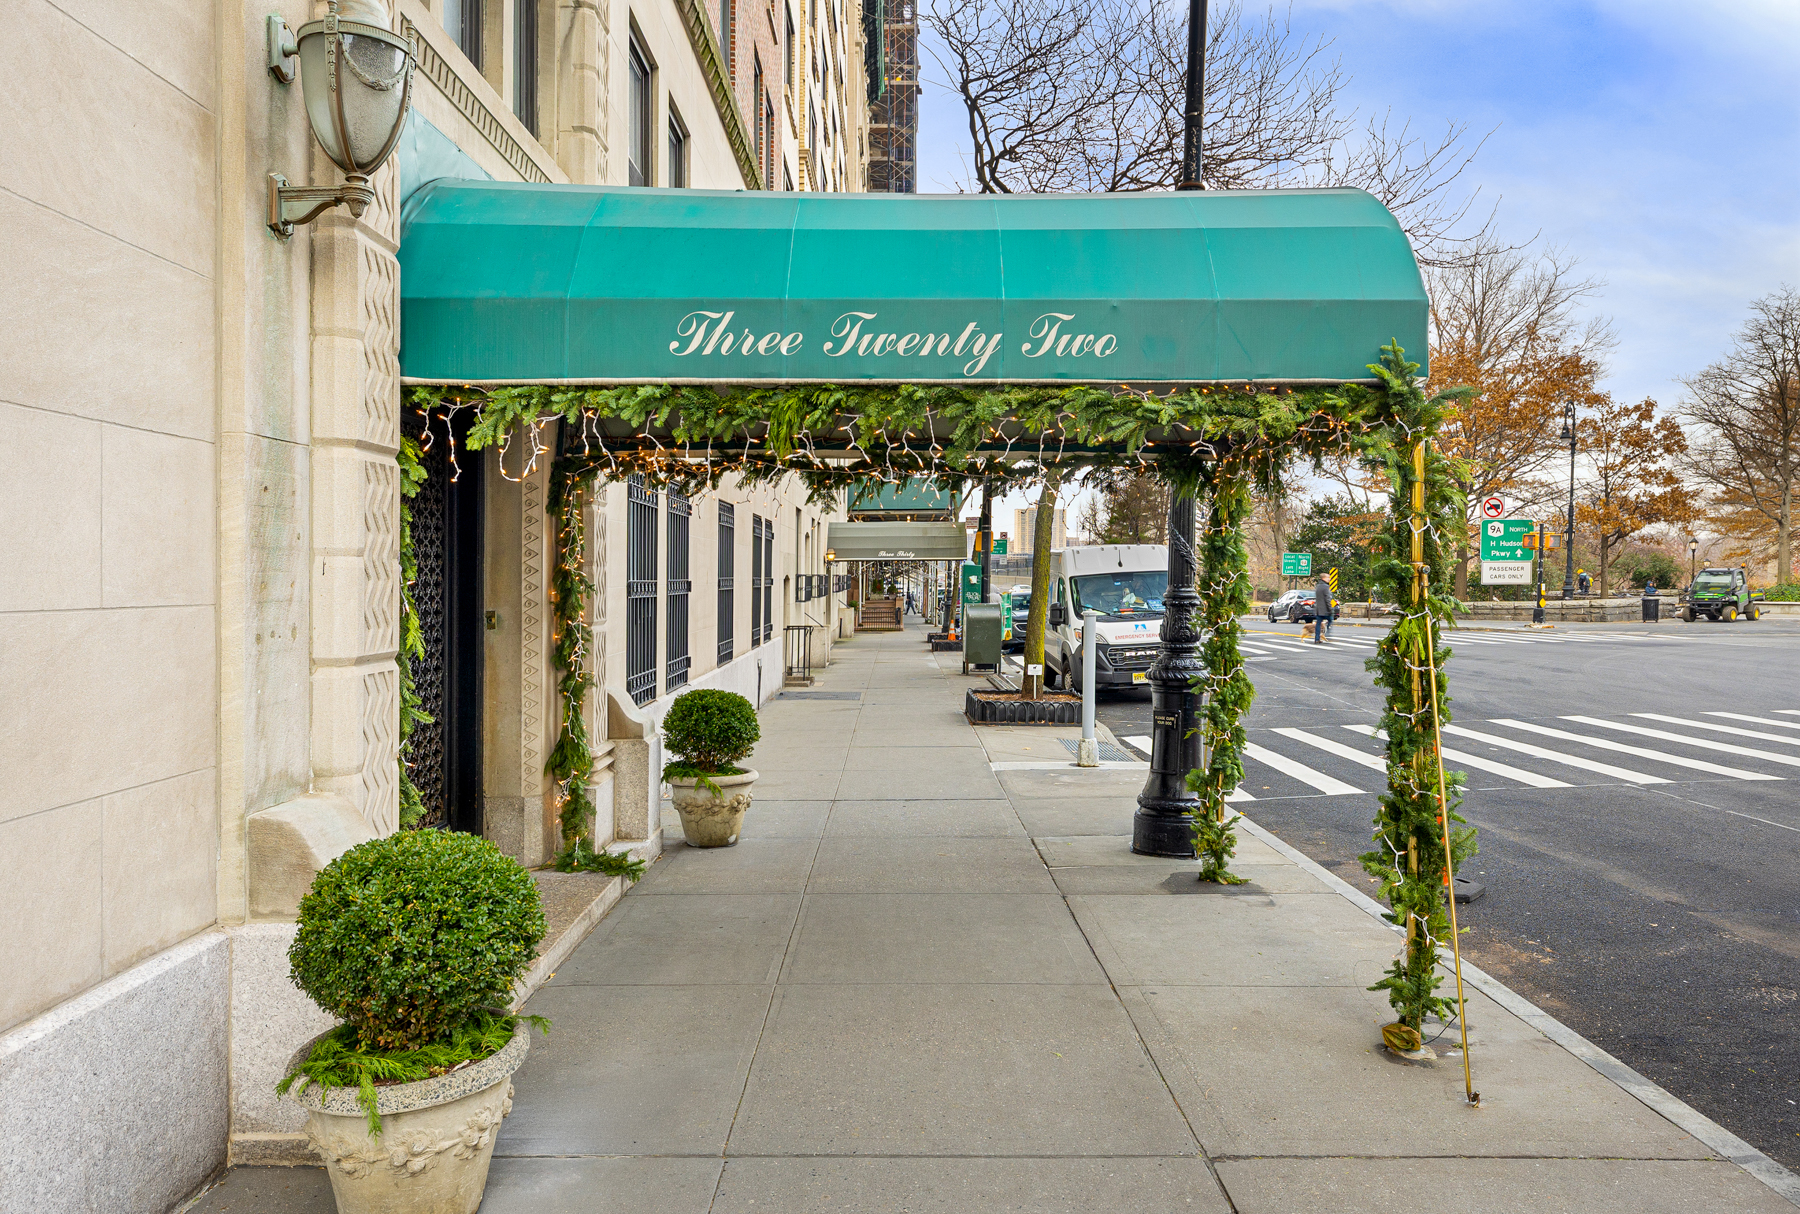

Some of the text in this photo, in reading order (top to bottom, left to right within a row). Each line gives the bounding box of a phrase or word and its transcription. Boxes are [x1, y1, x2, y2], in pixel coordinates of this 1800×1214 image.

[669, 311, 1118, 377] Three Twenty Two
[1490, 525, 1501, 533] 9A
[1491, 550, 1511, 558] Pkwy
